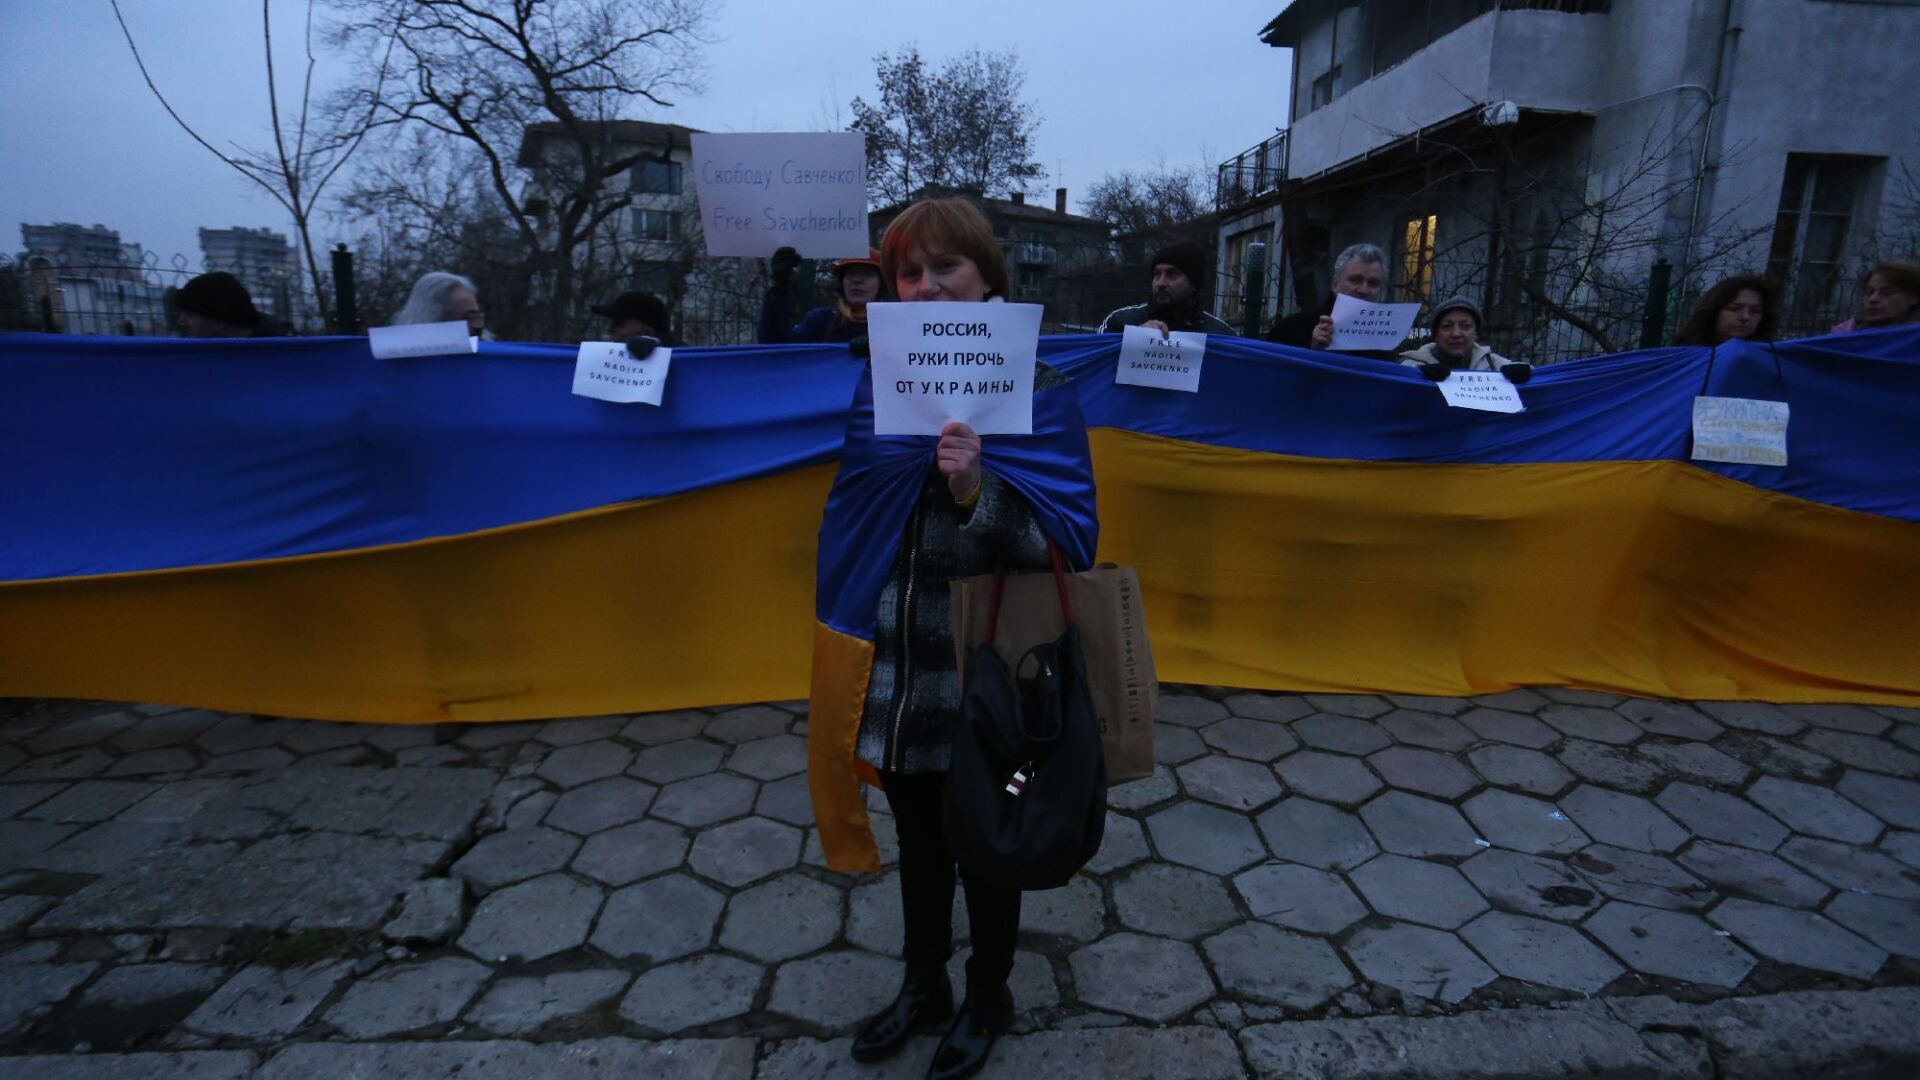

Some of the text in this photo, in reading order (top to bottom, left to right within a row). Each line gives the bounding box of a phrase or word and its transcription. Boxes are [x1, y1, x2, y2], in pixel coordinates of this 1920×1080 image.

[702, 160, 862, 191] Свободу Савченко!
[713, 207, 862, 232] Free Savchenko!
[1360, 309, 1393, 317] FREE
[922, 323, 992, 339] РОССИЯ,
[1149, 337, 1182, 349] FREE
[608, 348, 634, 361] FRE
[908, 352, 1005, 366] РУКИ ПРОЧЬ
[1144, 351, 1181, 361] NADIYA
[603, 361, 644, 374] NADIYA
[1130, 361, 1189, 373] SAVCHENKO
[590, 371, 652, 386] SAVCHENKO
[896, 379, 1015, 395] ОТ УКРАИНЫ
